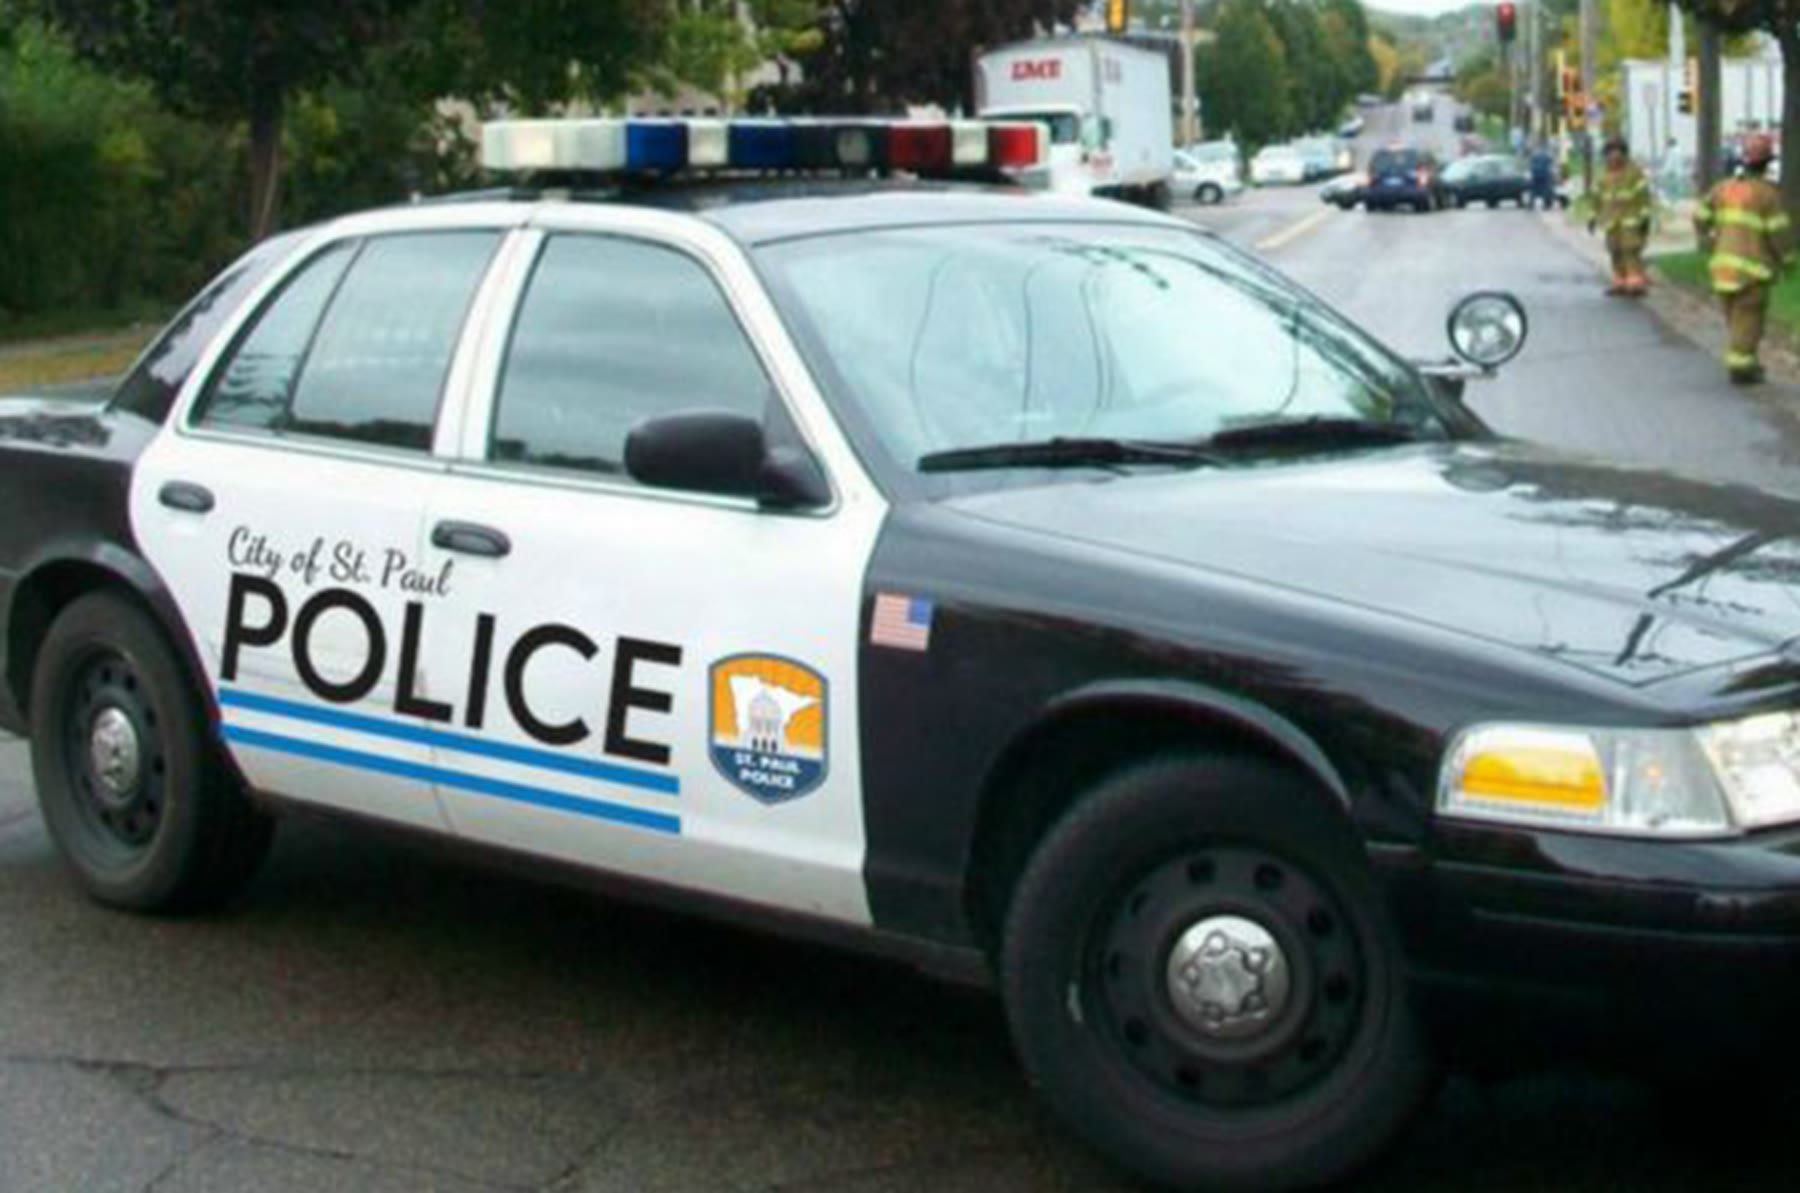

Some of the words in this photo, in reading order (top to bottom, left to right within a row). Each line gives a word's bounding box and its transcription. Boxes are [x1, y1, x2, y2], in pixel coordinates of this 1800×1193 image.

[227, 526, 281, 576] City
[290, 537, 324, 585] of
[329, 540, 370, 583] St.
[381, 547, 454, 596] Paul
[220, 572, 682, 766] POLICE
[739, 768, 795, 789] POLICE
[760, 756, 801, 774] PAUL
